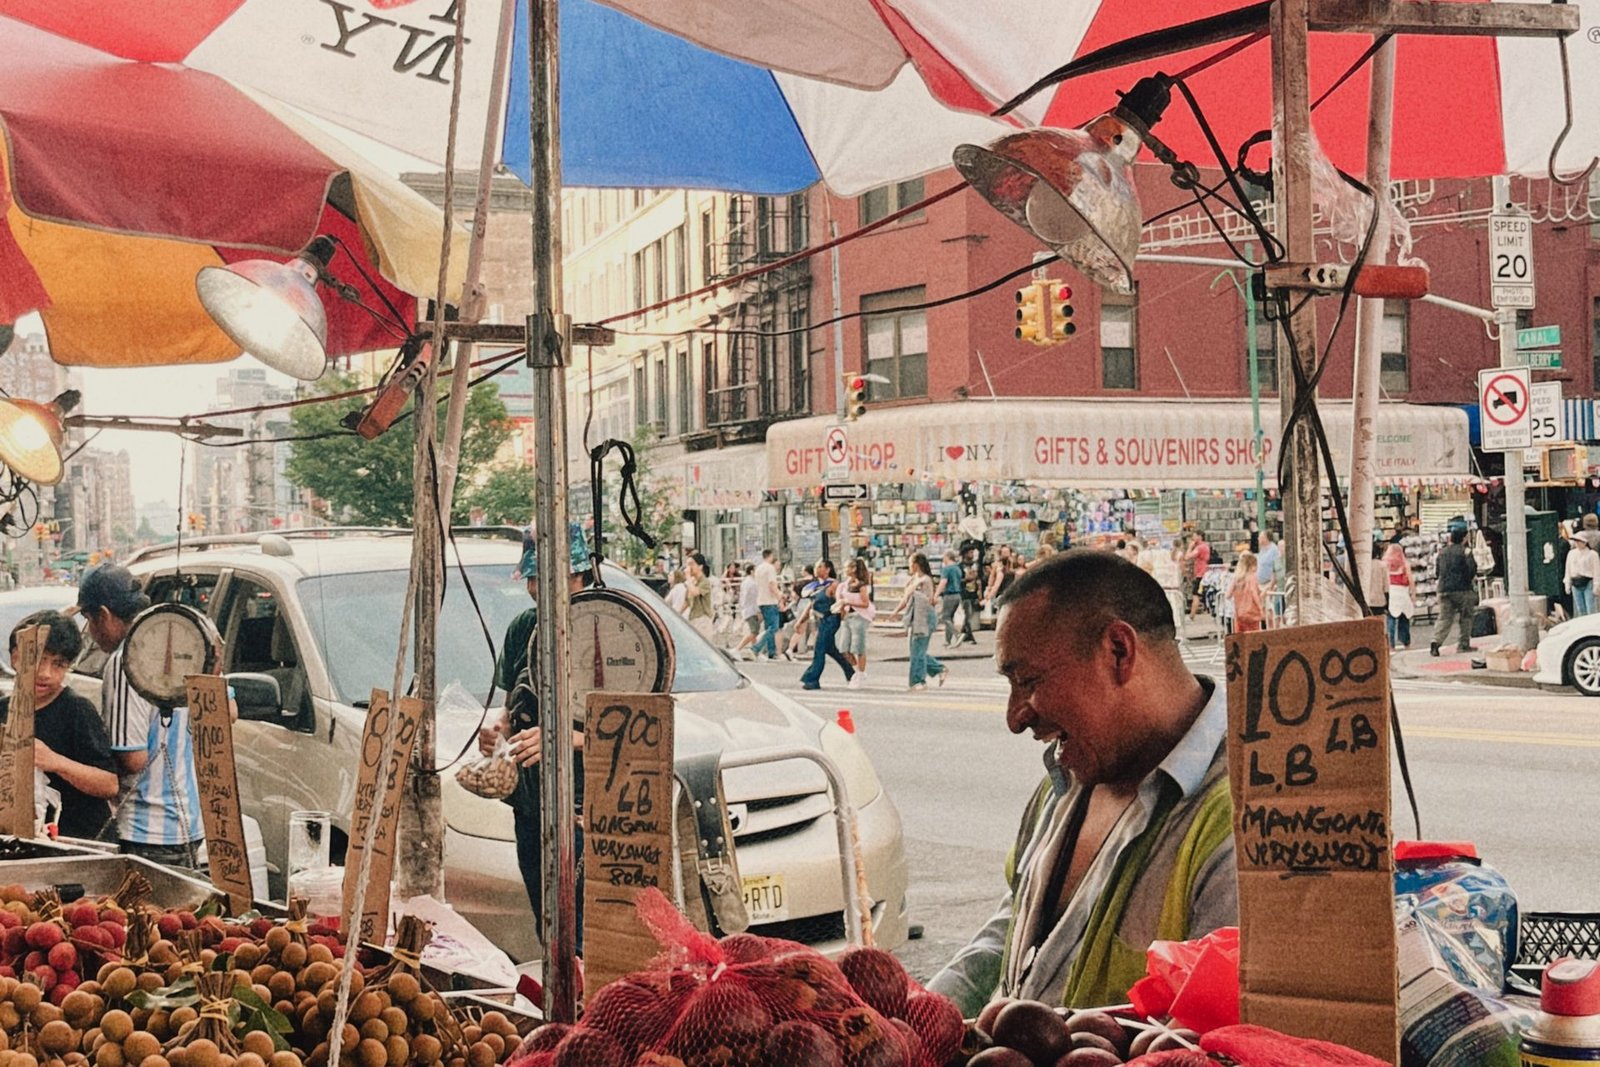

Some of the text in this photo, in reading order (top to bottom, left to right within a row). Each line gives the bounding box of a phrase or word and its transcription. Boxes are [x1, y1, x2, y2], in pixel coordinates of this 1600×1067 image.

[1494, 221, 1527, 232] SPEED
[1497, 236, 1524, 247] LIMIT
[1497, 254, 1527, 278] 20
[1519, 331, 1549, 347] CANAL
[1533, 397, 1552, 405] PEED
[1532, 417, 1556, 438] 25
[1377, 434, 1412, 443] ELCOME
[966, 443, 994, 461] NY
[1035, 437, 1272, 466] GIFTS & SOUVENIRS SHOP
[786, 448, 824, 475] GIFT
[751, 885, 782, 911] RTD
